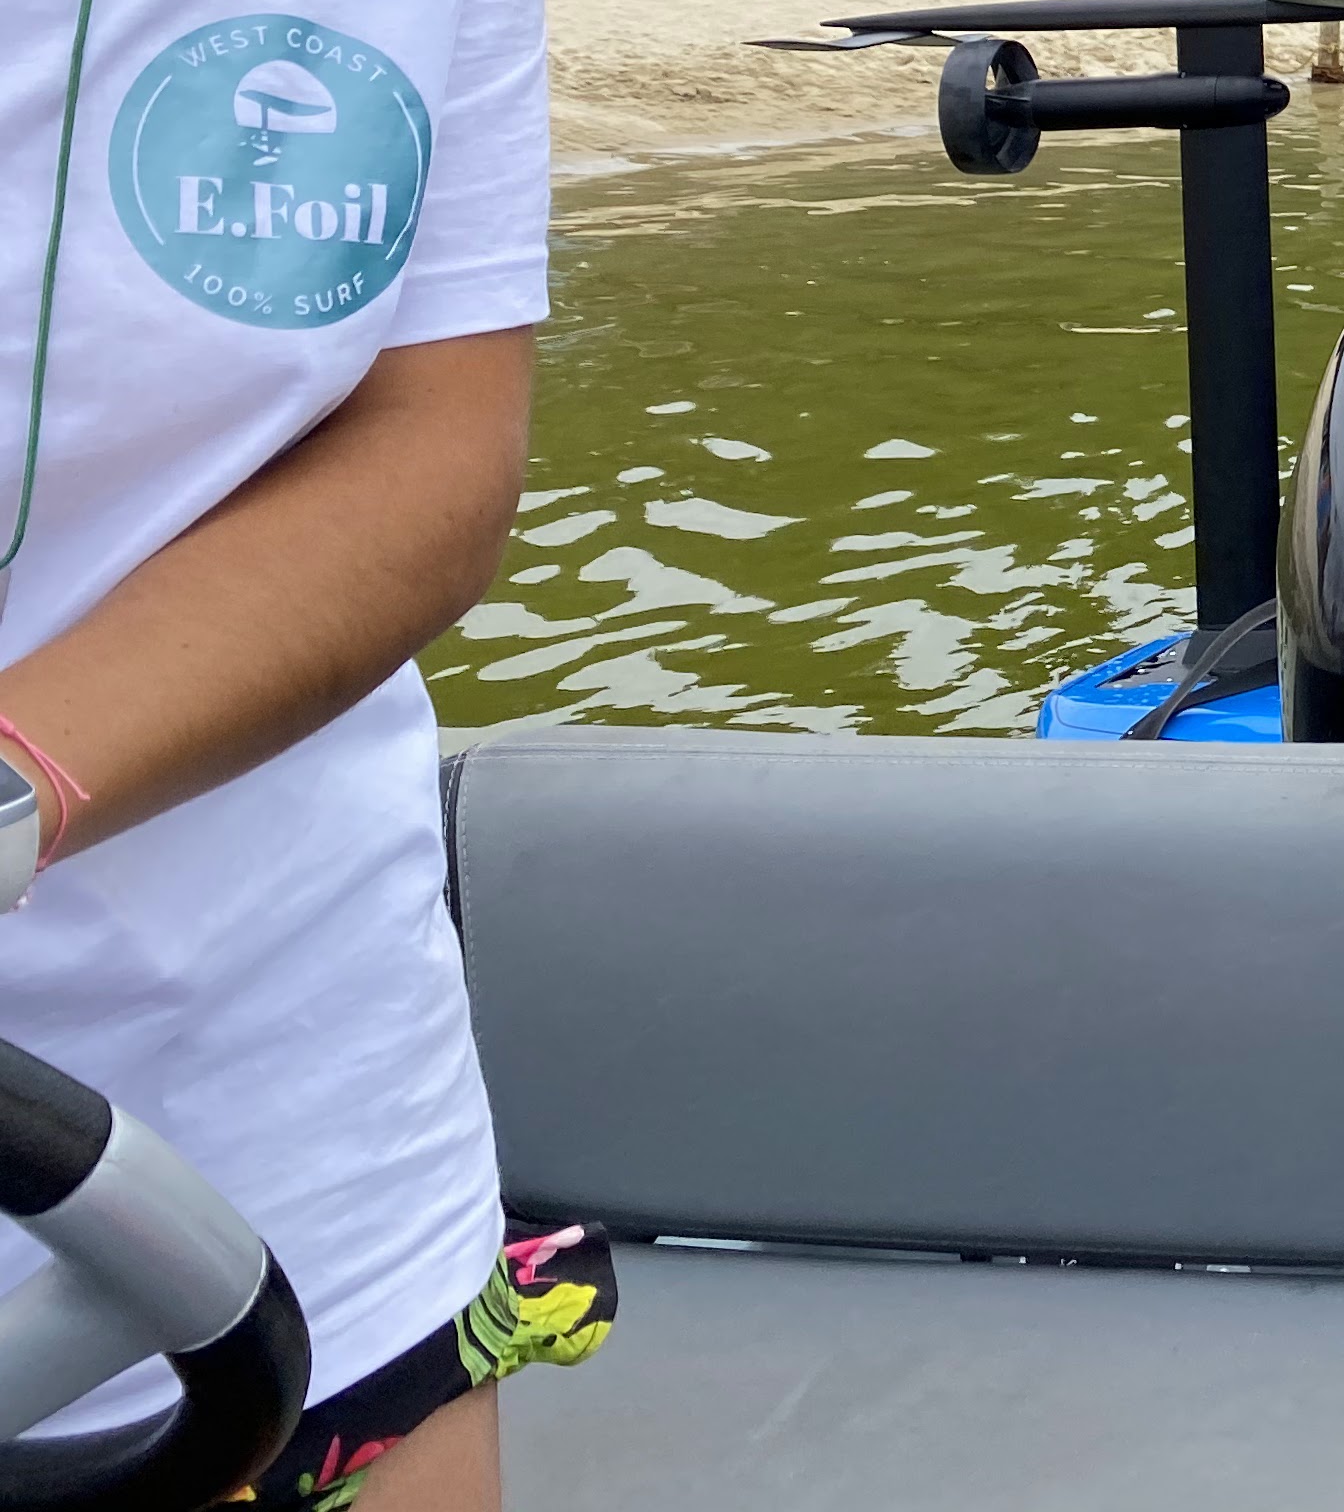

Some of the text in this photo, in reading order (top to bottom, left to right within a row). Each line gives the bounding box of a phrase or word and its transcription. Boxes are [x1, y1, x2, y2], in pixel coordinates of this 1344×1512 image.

[178, 25, 388, 82] WEST COAST
[174, 175, 388, 245] E.Foil
[183, 263, 365, 316] 100% SURF
